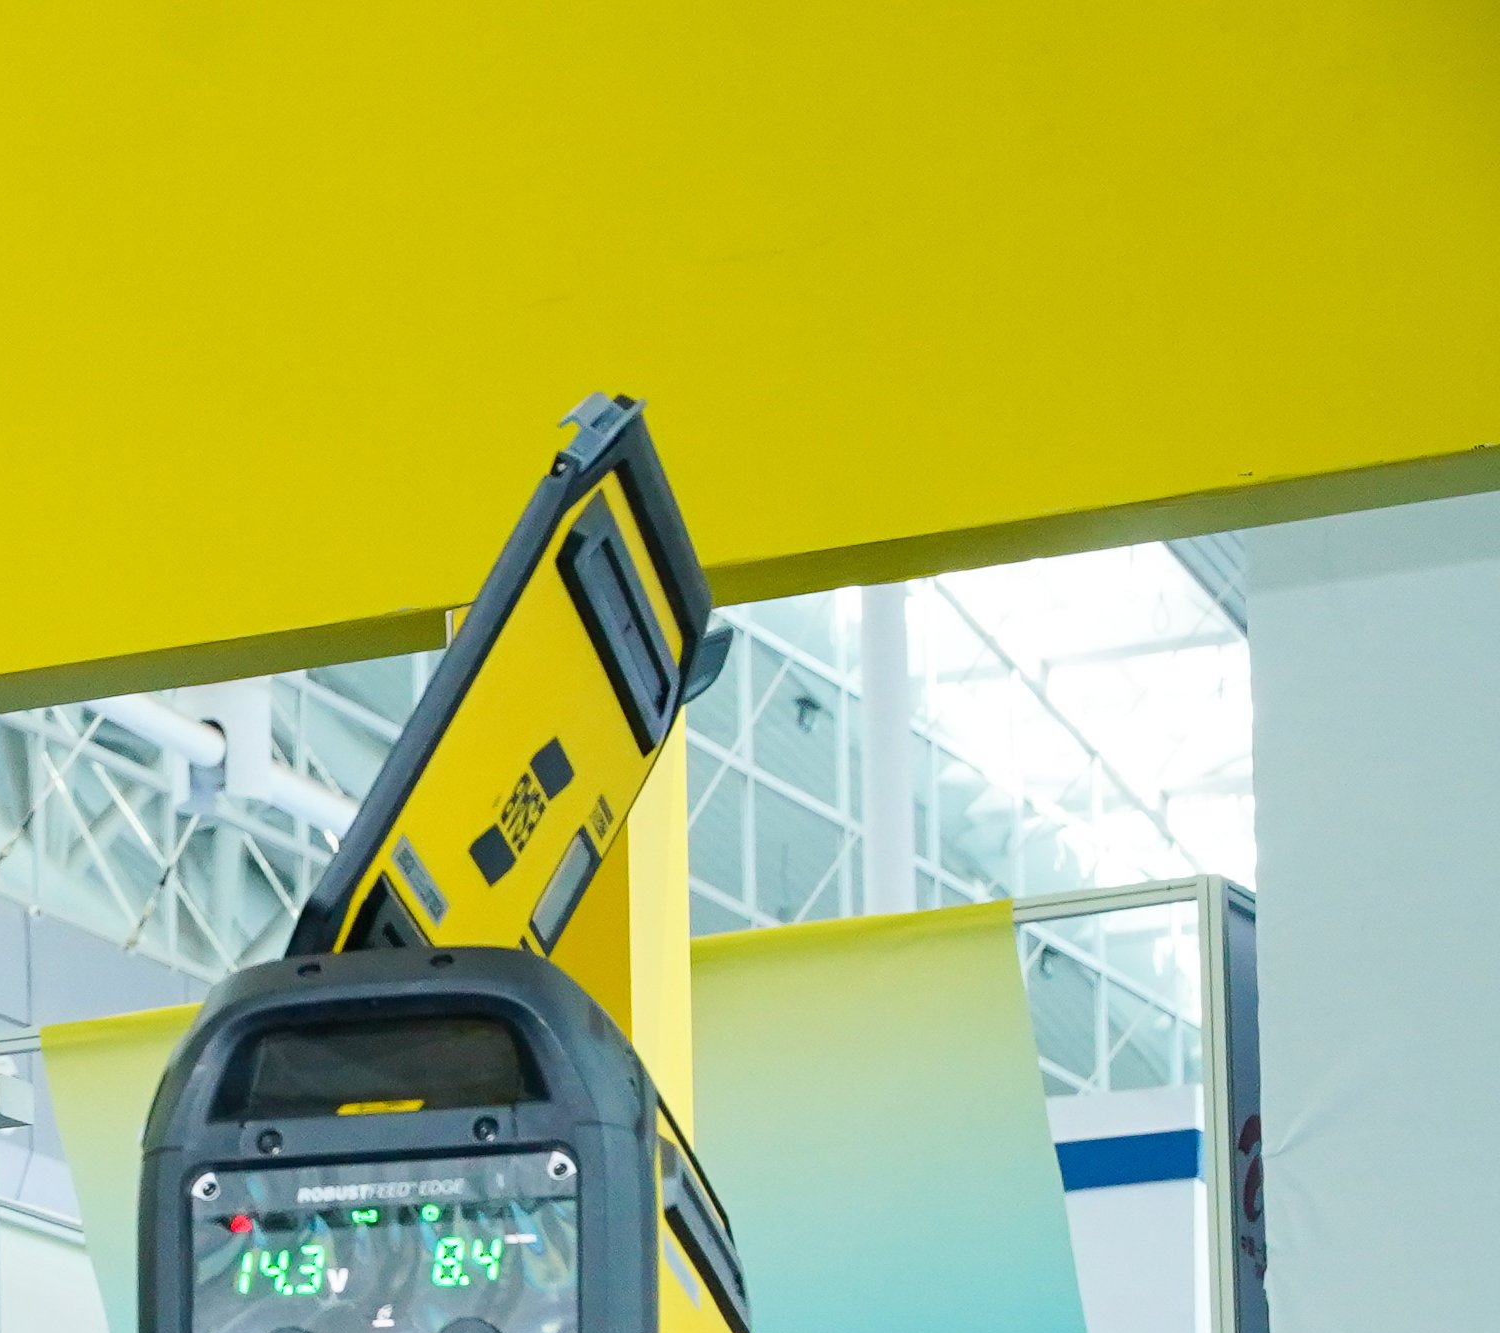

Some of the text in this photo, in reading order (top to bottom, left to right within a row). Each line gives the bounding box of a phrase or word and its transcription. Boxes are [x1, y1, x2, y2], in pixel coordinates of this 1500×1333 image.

[237, 1244, 349, 1296] 14.3 V
[432, 1236, 504, 1287] 8.4
